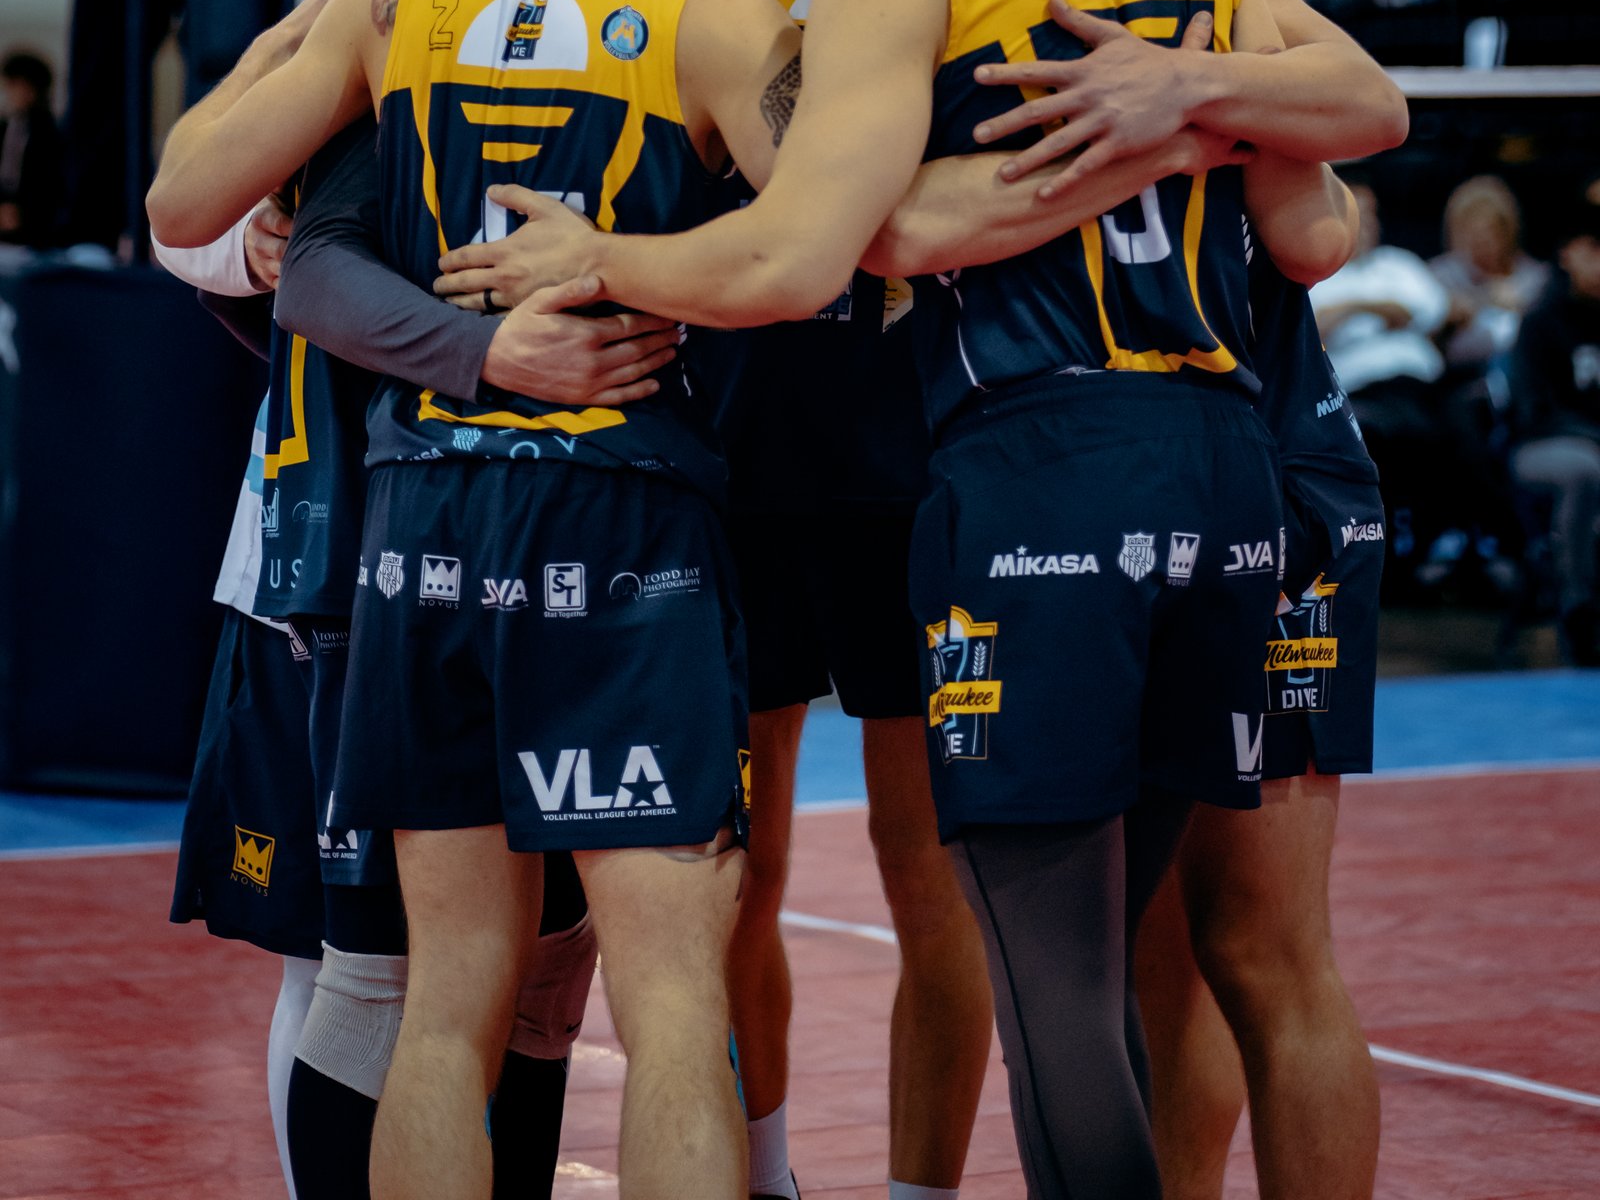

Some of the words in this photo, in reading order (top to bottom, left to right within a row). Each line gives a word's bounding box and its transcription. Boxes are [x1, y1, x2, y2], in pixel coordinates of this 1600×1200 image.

[1223, 541, 1274, 572] JVA
[643, 569, 681, 584] TODD
[685, 566, 700, 580] JAY
[643, 578, 701, 593] PHOTOGRAPHY
[418, 599, 460, 610] NOVUS
[543, 610, 558, 619] Stat
[558, 610, 589, 620] Together
[1281, 687, 1318, 710] DIVE
[517, 745, 674, 812] VLA
[542, 812, 593, 822] VOLLEYBALL
[594, 810, 626, 819] LEAGUE
[627, 809, 639, 817] OF
[640, 807, 678, 817] AMERICA
[229, 871, 269, 897] NOVUS
